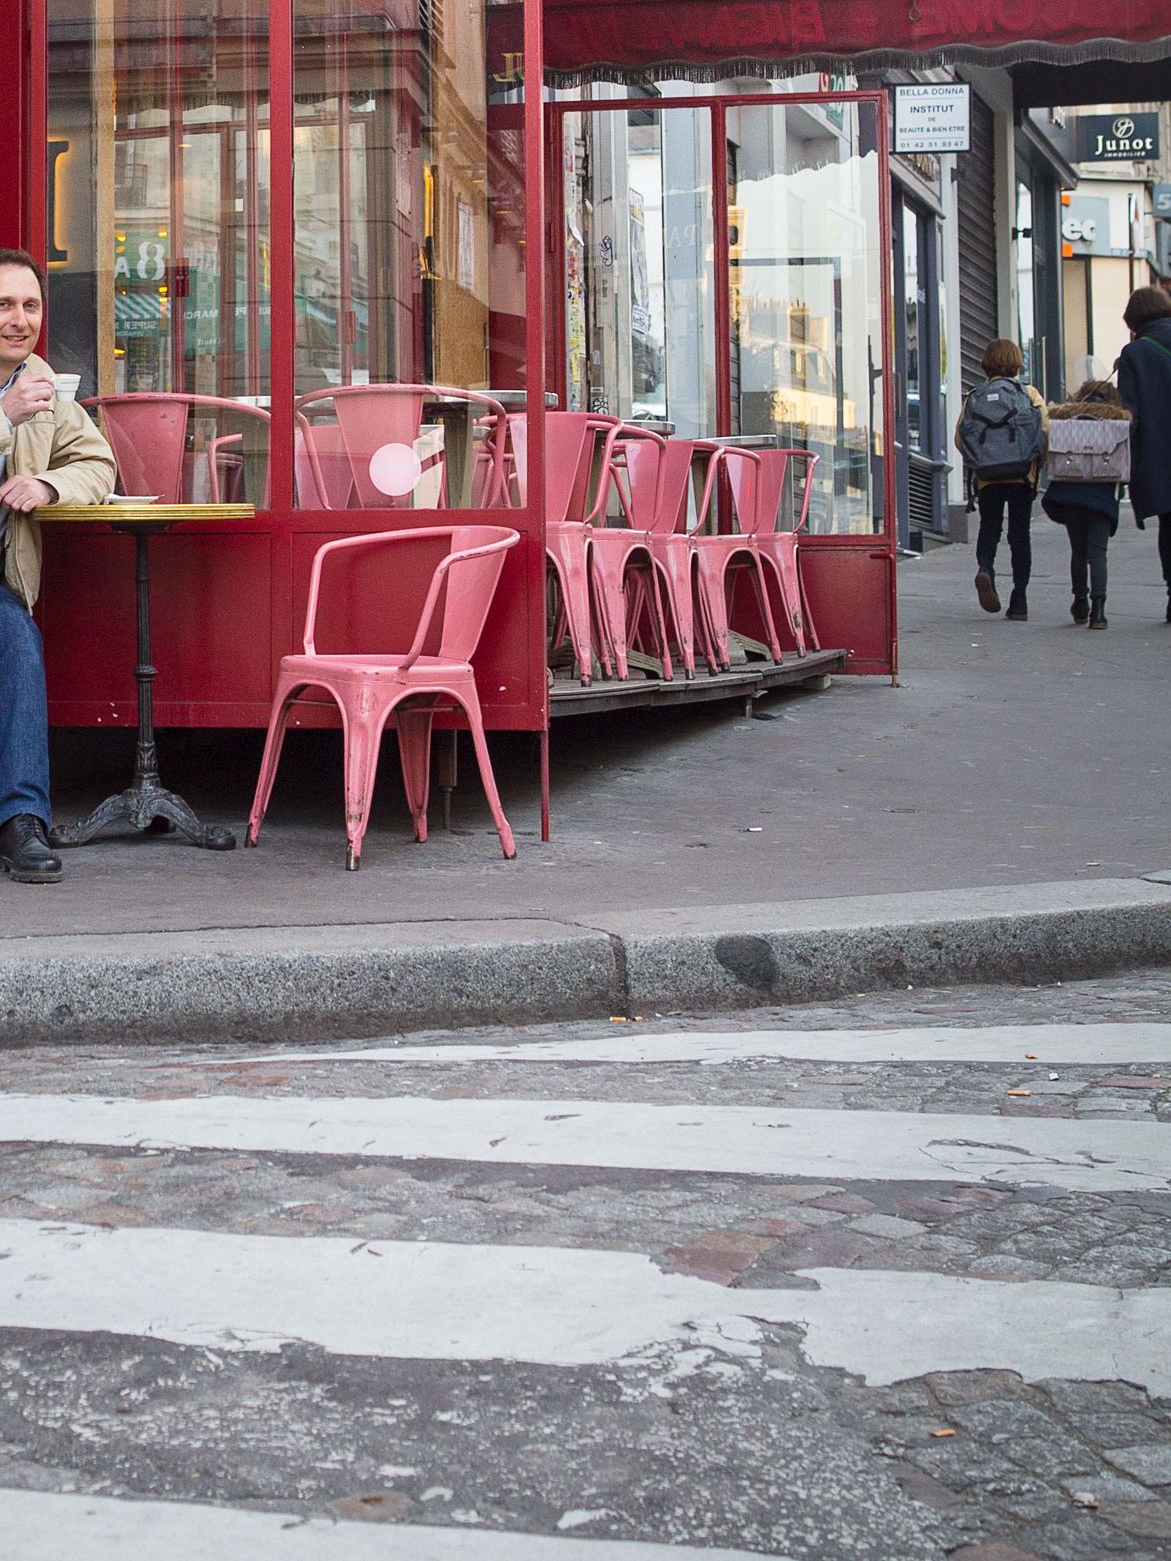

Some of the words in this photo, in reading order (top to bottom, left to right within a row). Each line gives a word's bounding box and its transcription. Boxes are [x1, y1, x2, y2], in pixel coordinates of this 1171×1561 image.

[900, 88, 929, 97] BELLA
[931, 87, 965, 96] DONNA
[910, 104, 954, 114] INSTITUT
[1095, 135, 1153, 156] Junot
